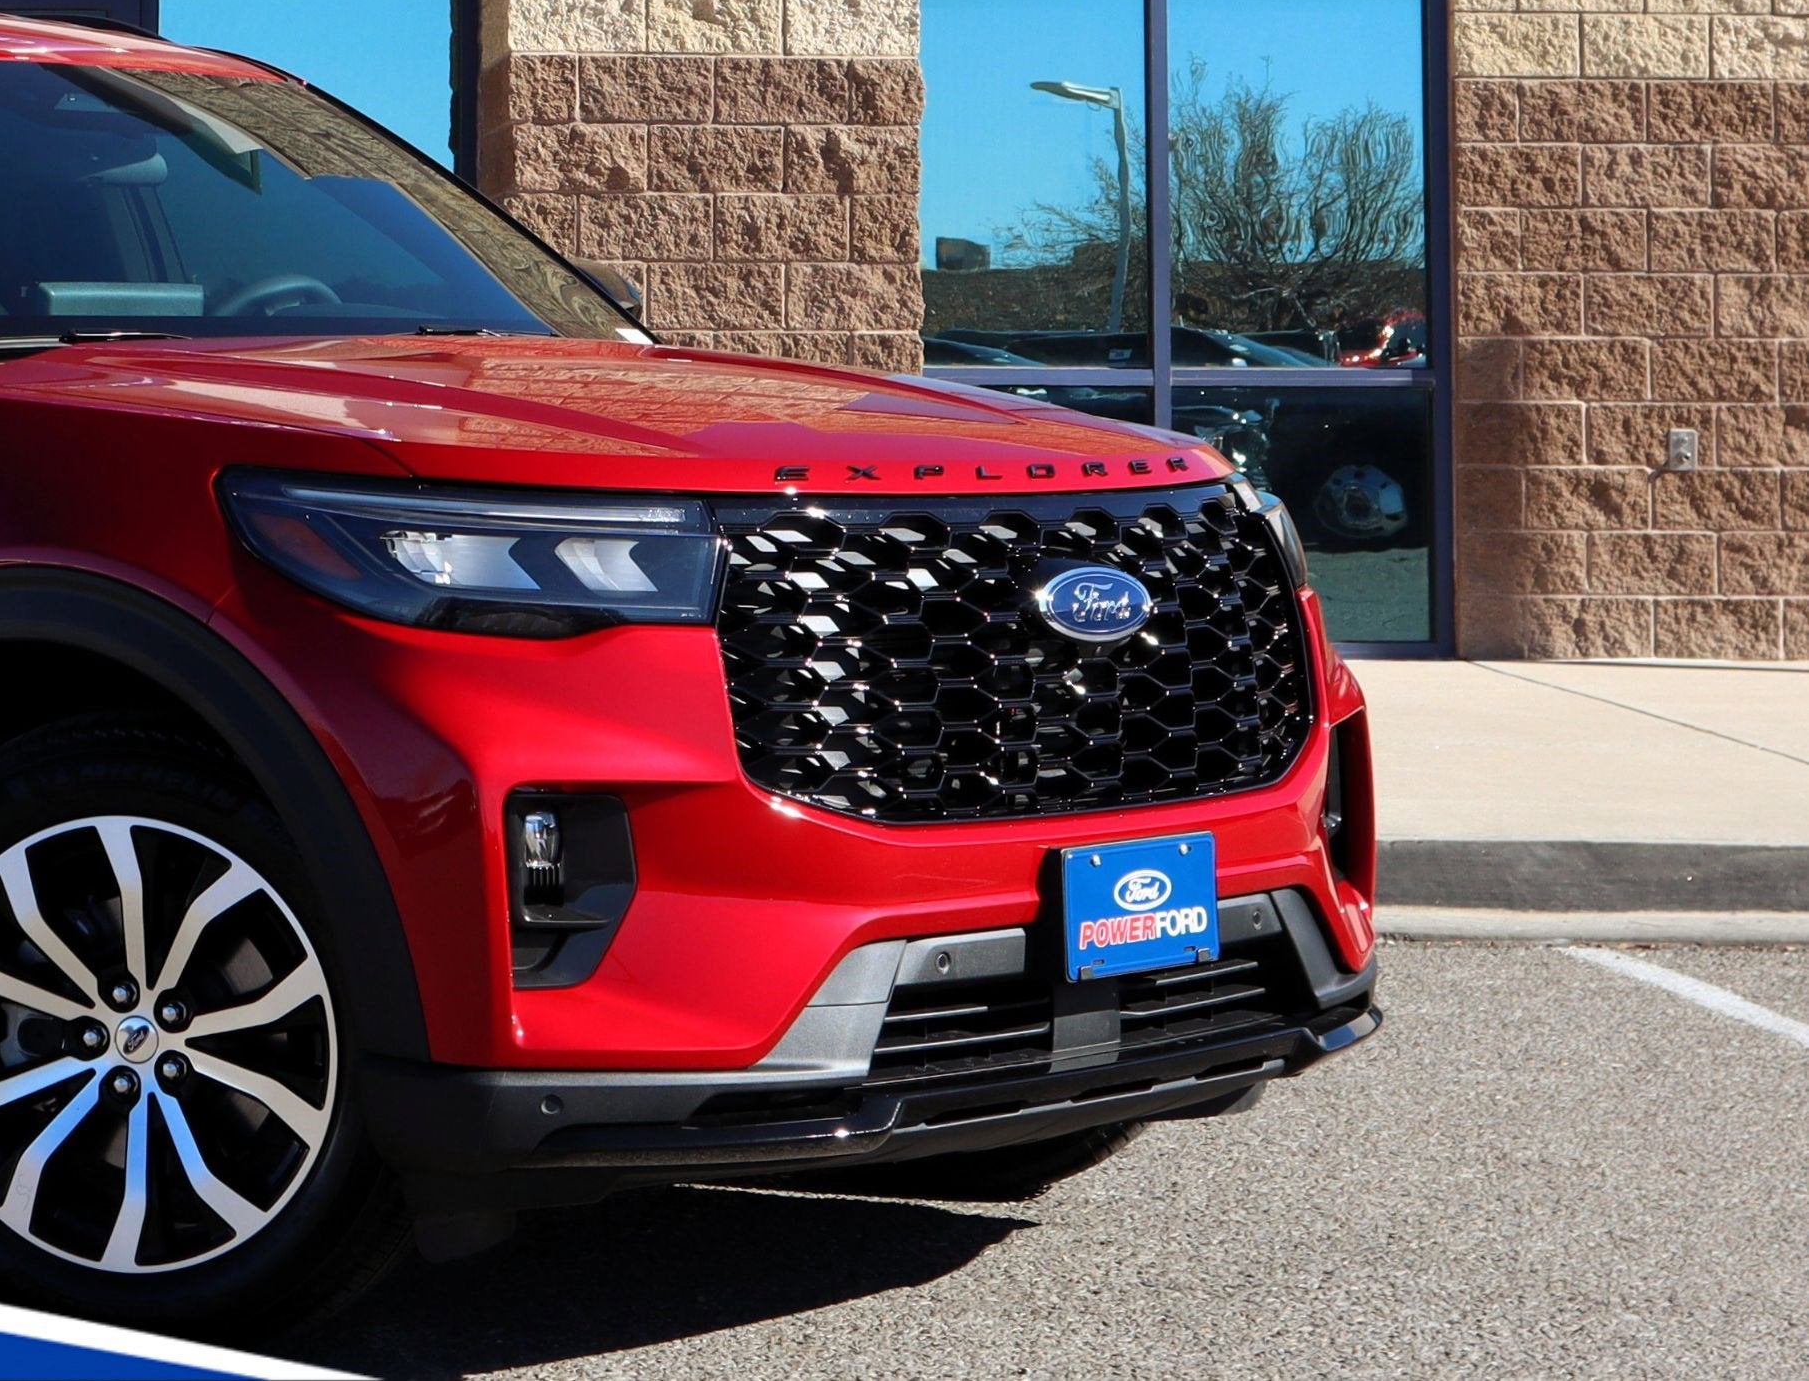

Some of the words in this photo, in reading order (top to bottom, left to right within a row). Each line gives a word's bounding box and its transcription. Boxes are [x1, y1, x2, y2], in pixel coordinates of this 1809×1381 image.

[774, 456, 1190, 482] EXPLORER
[1071, 582, 1132, 623] Ford
[1125, 876, 1161, 903] Ford
